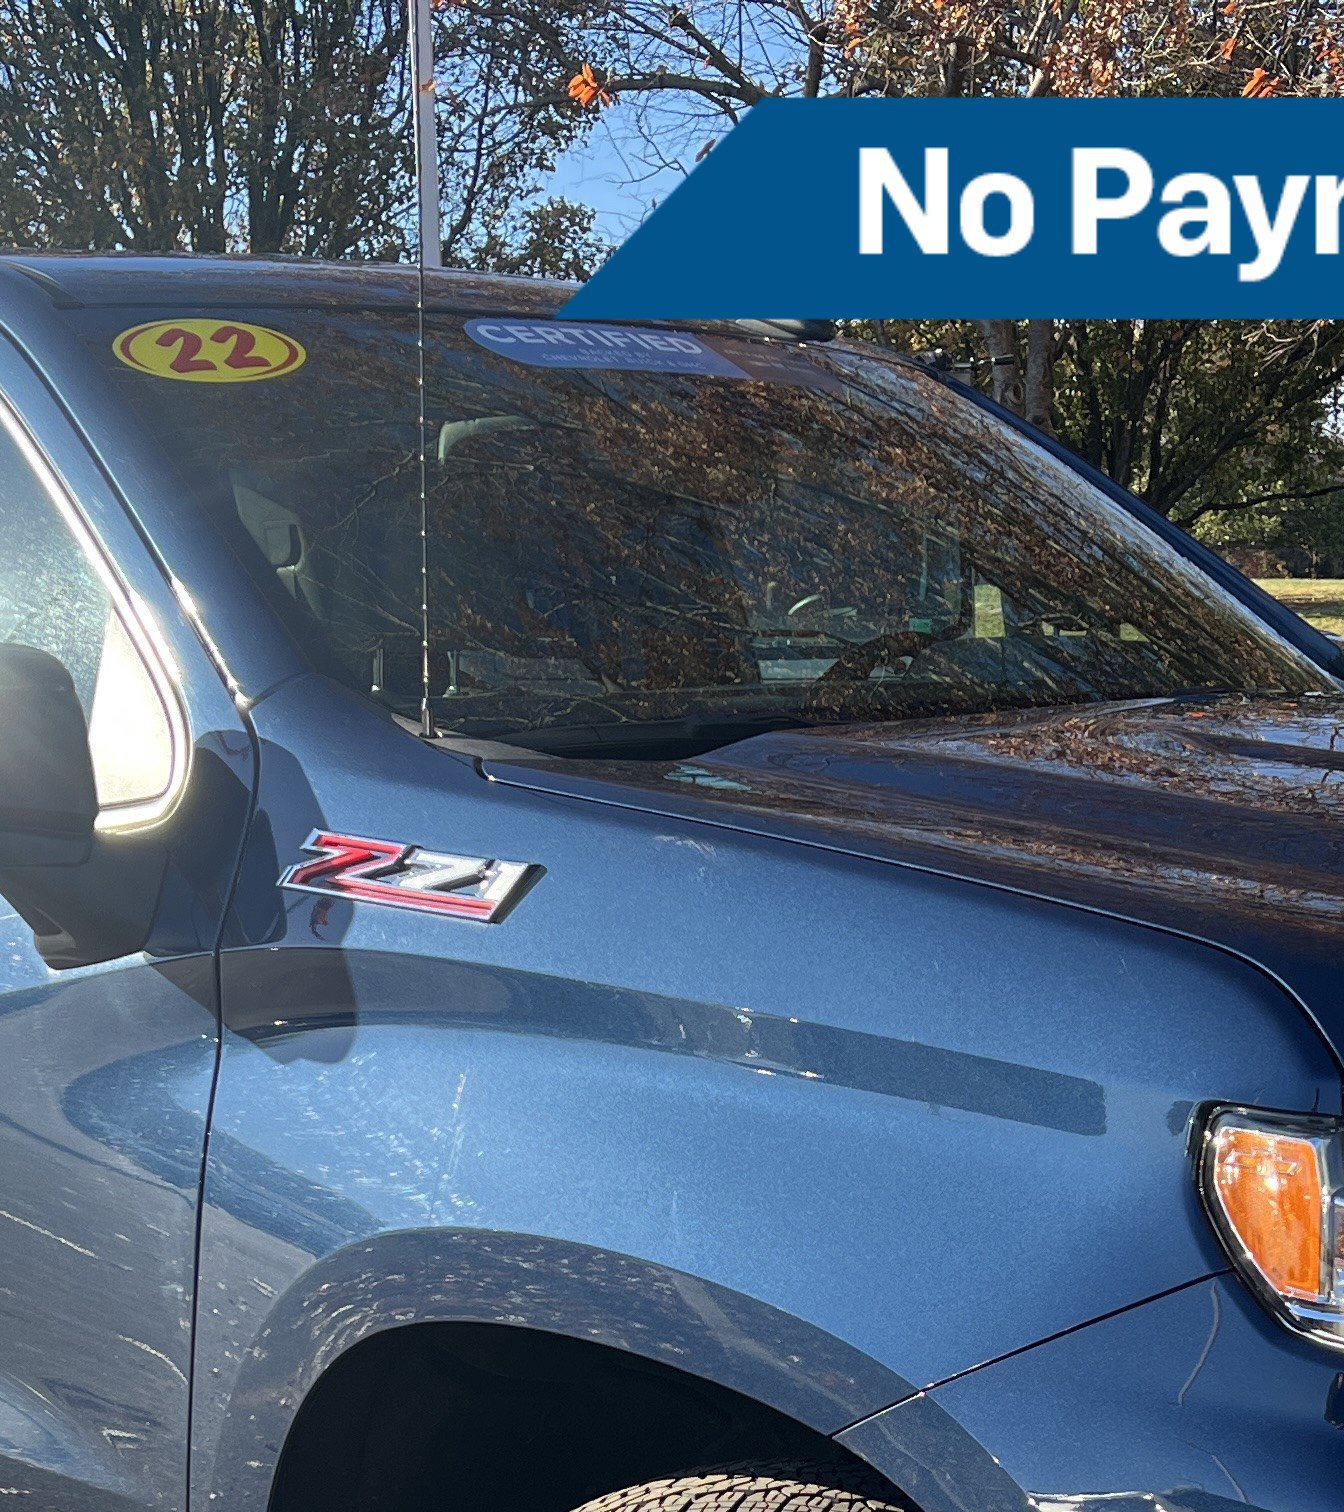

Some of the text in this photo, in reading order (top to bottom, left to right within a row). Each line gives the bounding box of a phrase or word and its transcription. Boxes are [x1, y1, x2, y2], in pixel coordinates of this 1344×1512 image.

[155, 326, 272, 373] 22
[475, 324, 704, 355] CERTIFIED
[278, 827, 547, 923] Z71
